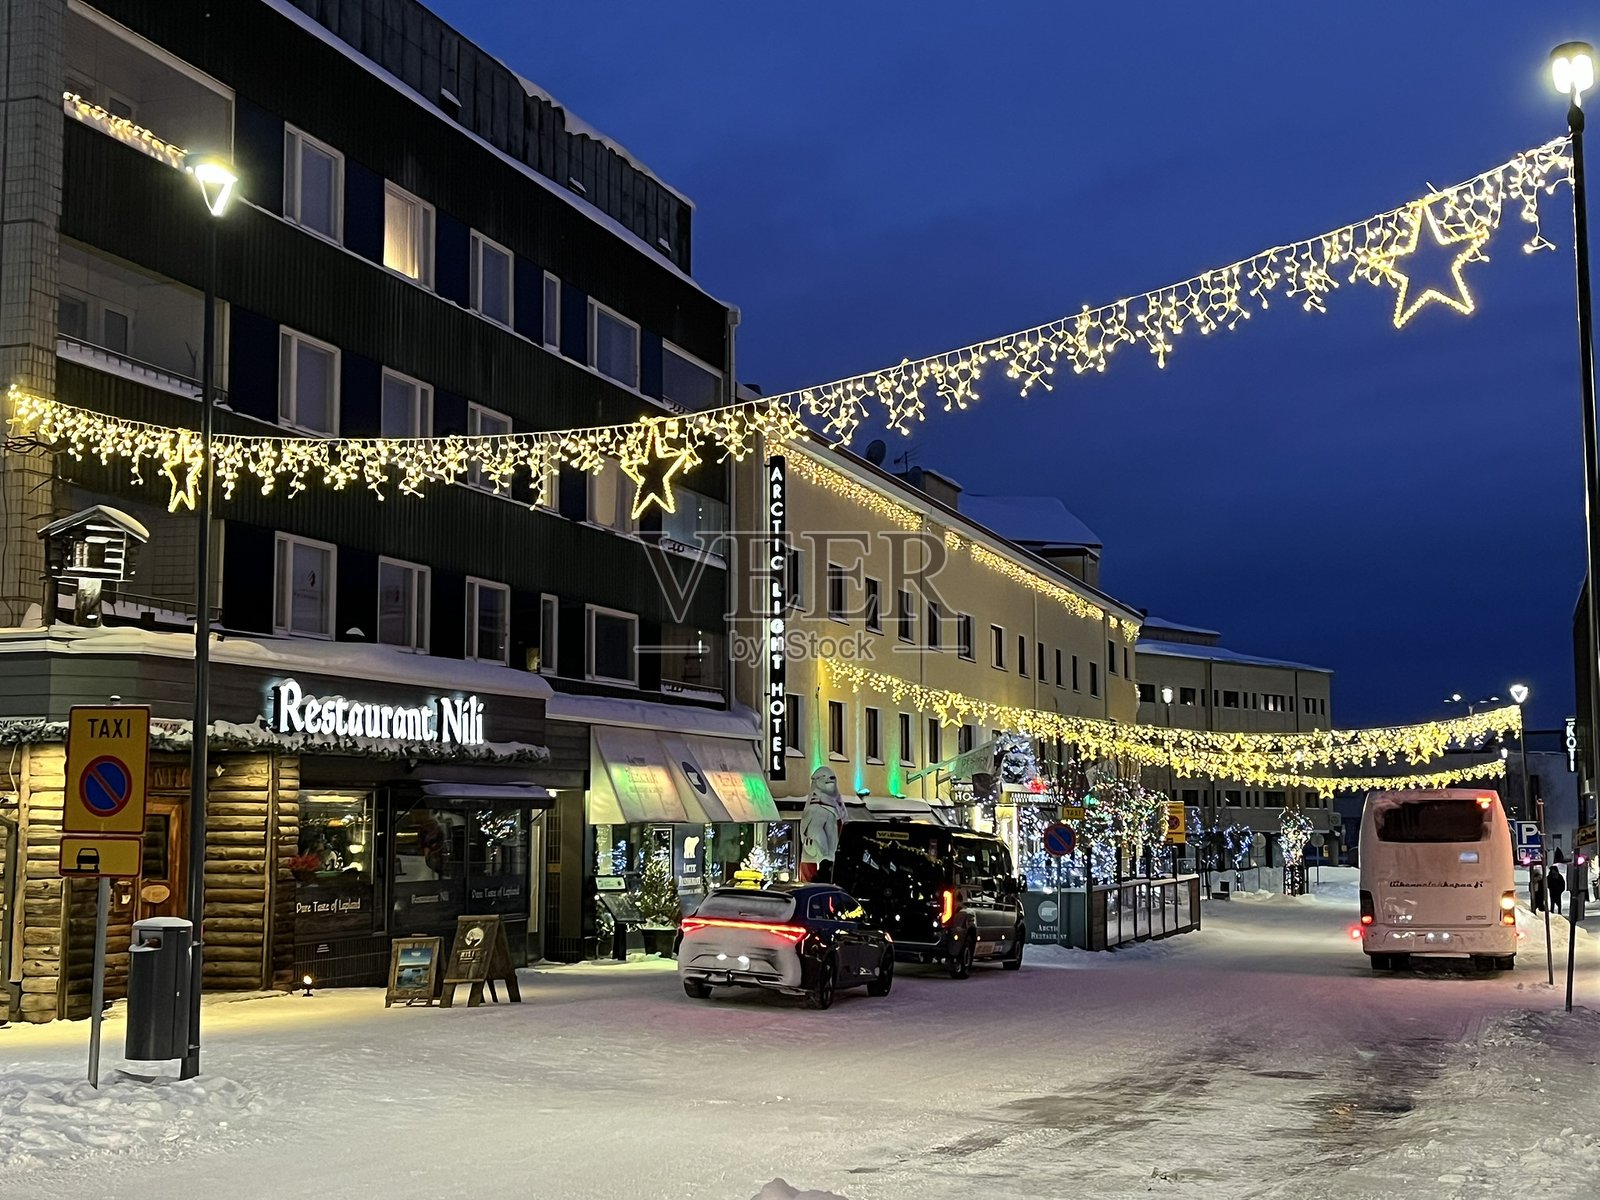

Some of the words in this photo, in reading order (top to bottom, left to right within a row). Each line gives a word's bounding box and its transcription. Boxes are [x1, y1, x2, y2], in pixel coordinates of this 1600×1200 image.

[770, 466, 784, 571] ARCTIC
[770, 582, 784, 670] LIGHT
[279, 679, 434, 741] Restaurant
[441, 695, 485, 745] Nili
[87, 718, 132, 739] TAXI
[770, 682, 784, 771] HOTEL
[1066, 809, 1082, 817] TAXI
[1521, 823, 1539, 844] P
[313, 901, 330, 912] Taste
[331, 899, 338, 914] of
[339, 898, 361, 914] Lapland
[1030, 931, 1068, 940] RESTAURNT
